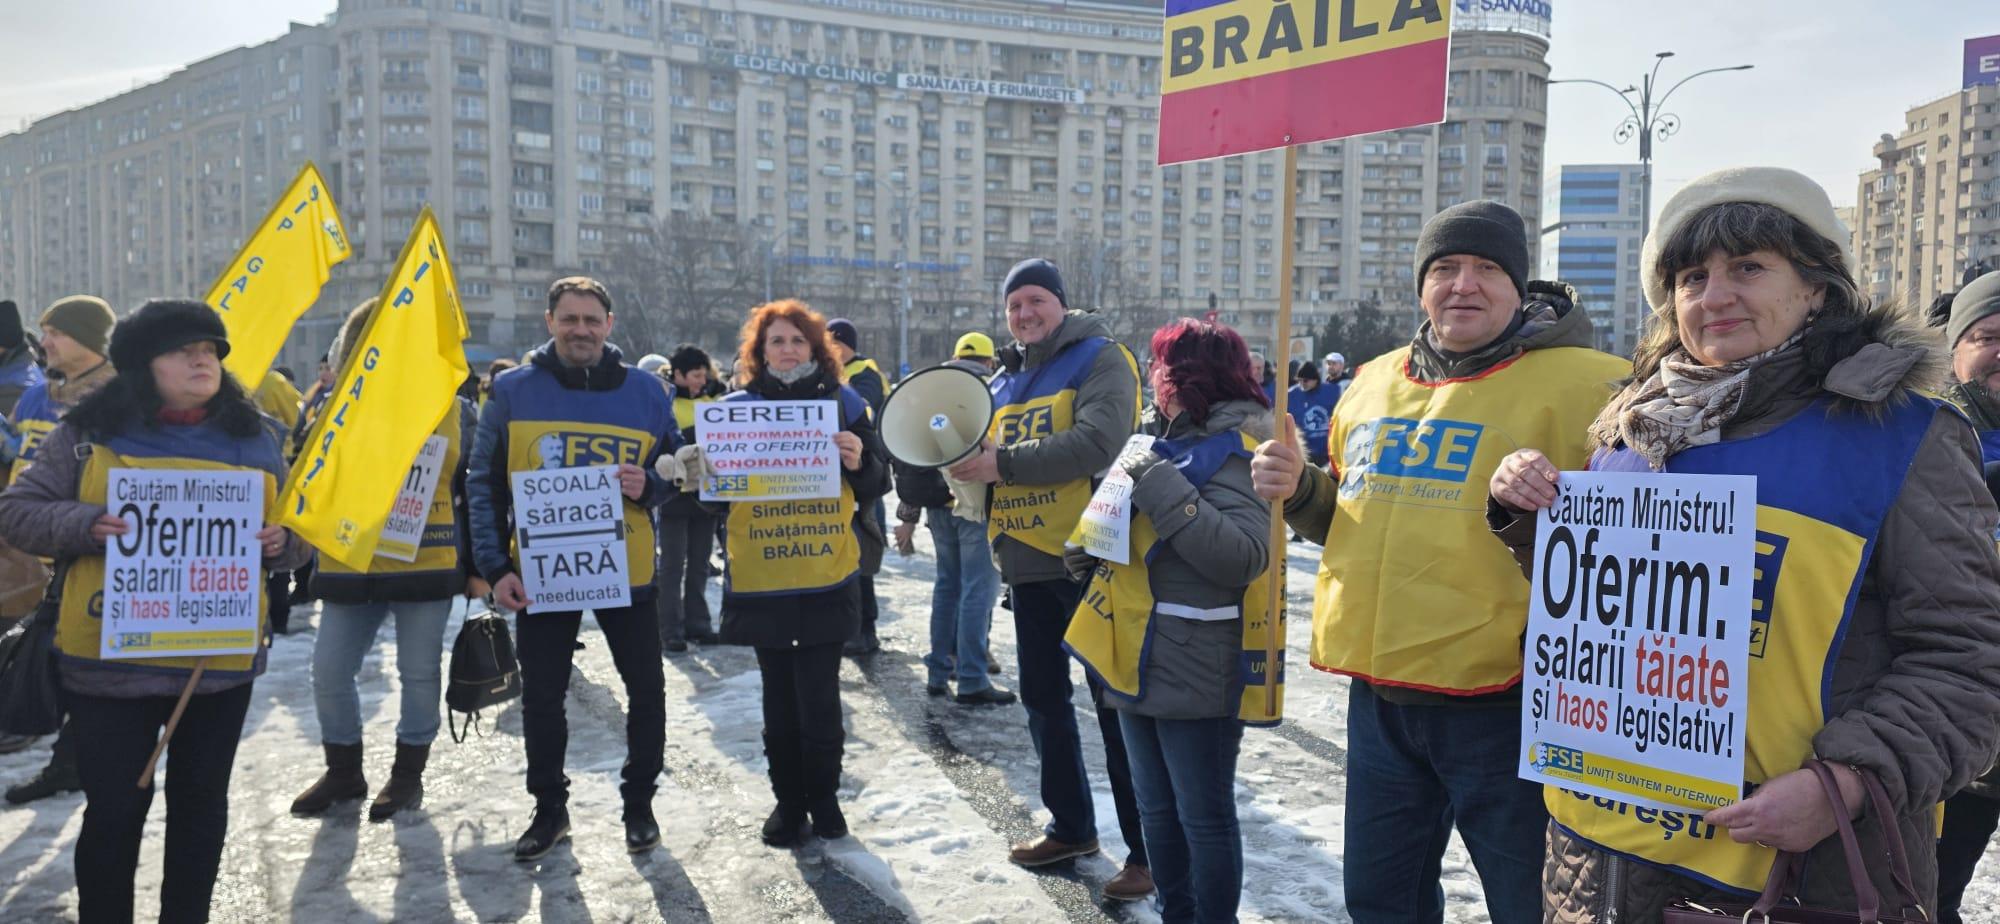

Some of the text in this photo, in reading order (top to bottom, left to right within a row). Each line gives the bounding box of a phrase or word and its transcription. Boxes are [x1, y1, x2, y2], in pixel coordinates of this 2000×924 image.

[734, 54, 887, 85] EDENT CLINIC
[988, 82, 997, 94] E
[703, 405, 824, 426] CEREȚI
[1000, 408, 1050, 446] FSE
[706, 440, 828, 454] DAR OFERIȚI
[1370, 423, 1479, 472] FSE
[714, 456, 829, 470] GNORANȚĂ!
[117, 478, 251, 502] Căutăm Ministru!
[523, 469, 611, 501] ȘCOALĂ
[717, 476, 747, 490] FSE
[1409, 482, 1463, 501] Haret
[526, 496, 613, 526] săracă
[752, 501, 841, 519] Sindicatul
[1548, 484, 1735, 535] Căutăm Ministru!
[116, 503, 249, 557] Oferim:
[530, 543, 618, 587] ȚARĂ
[763, 542, 833, 560] BRĂILA
[112, 559, 249, 593] salarii tăiate
[1542, 525, 1730, 640] Oferim:
[536, 584, 621, 603] needucată
[111, 595, 125, 628] și
[131, 595, 170, 618] haos
[176, 593, 252, 624] legislativ!
[1534, 624, 1730, 708] salarii tăiate
[1532, 680, 1734, 758] și haos legislativ!
[1547, 746, 1583, 770] FSE
[1586, 765, 1614, 784] UNIȚI
[1617, 773, 1662, 793] SUNTEM
